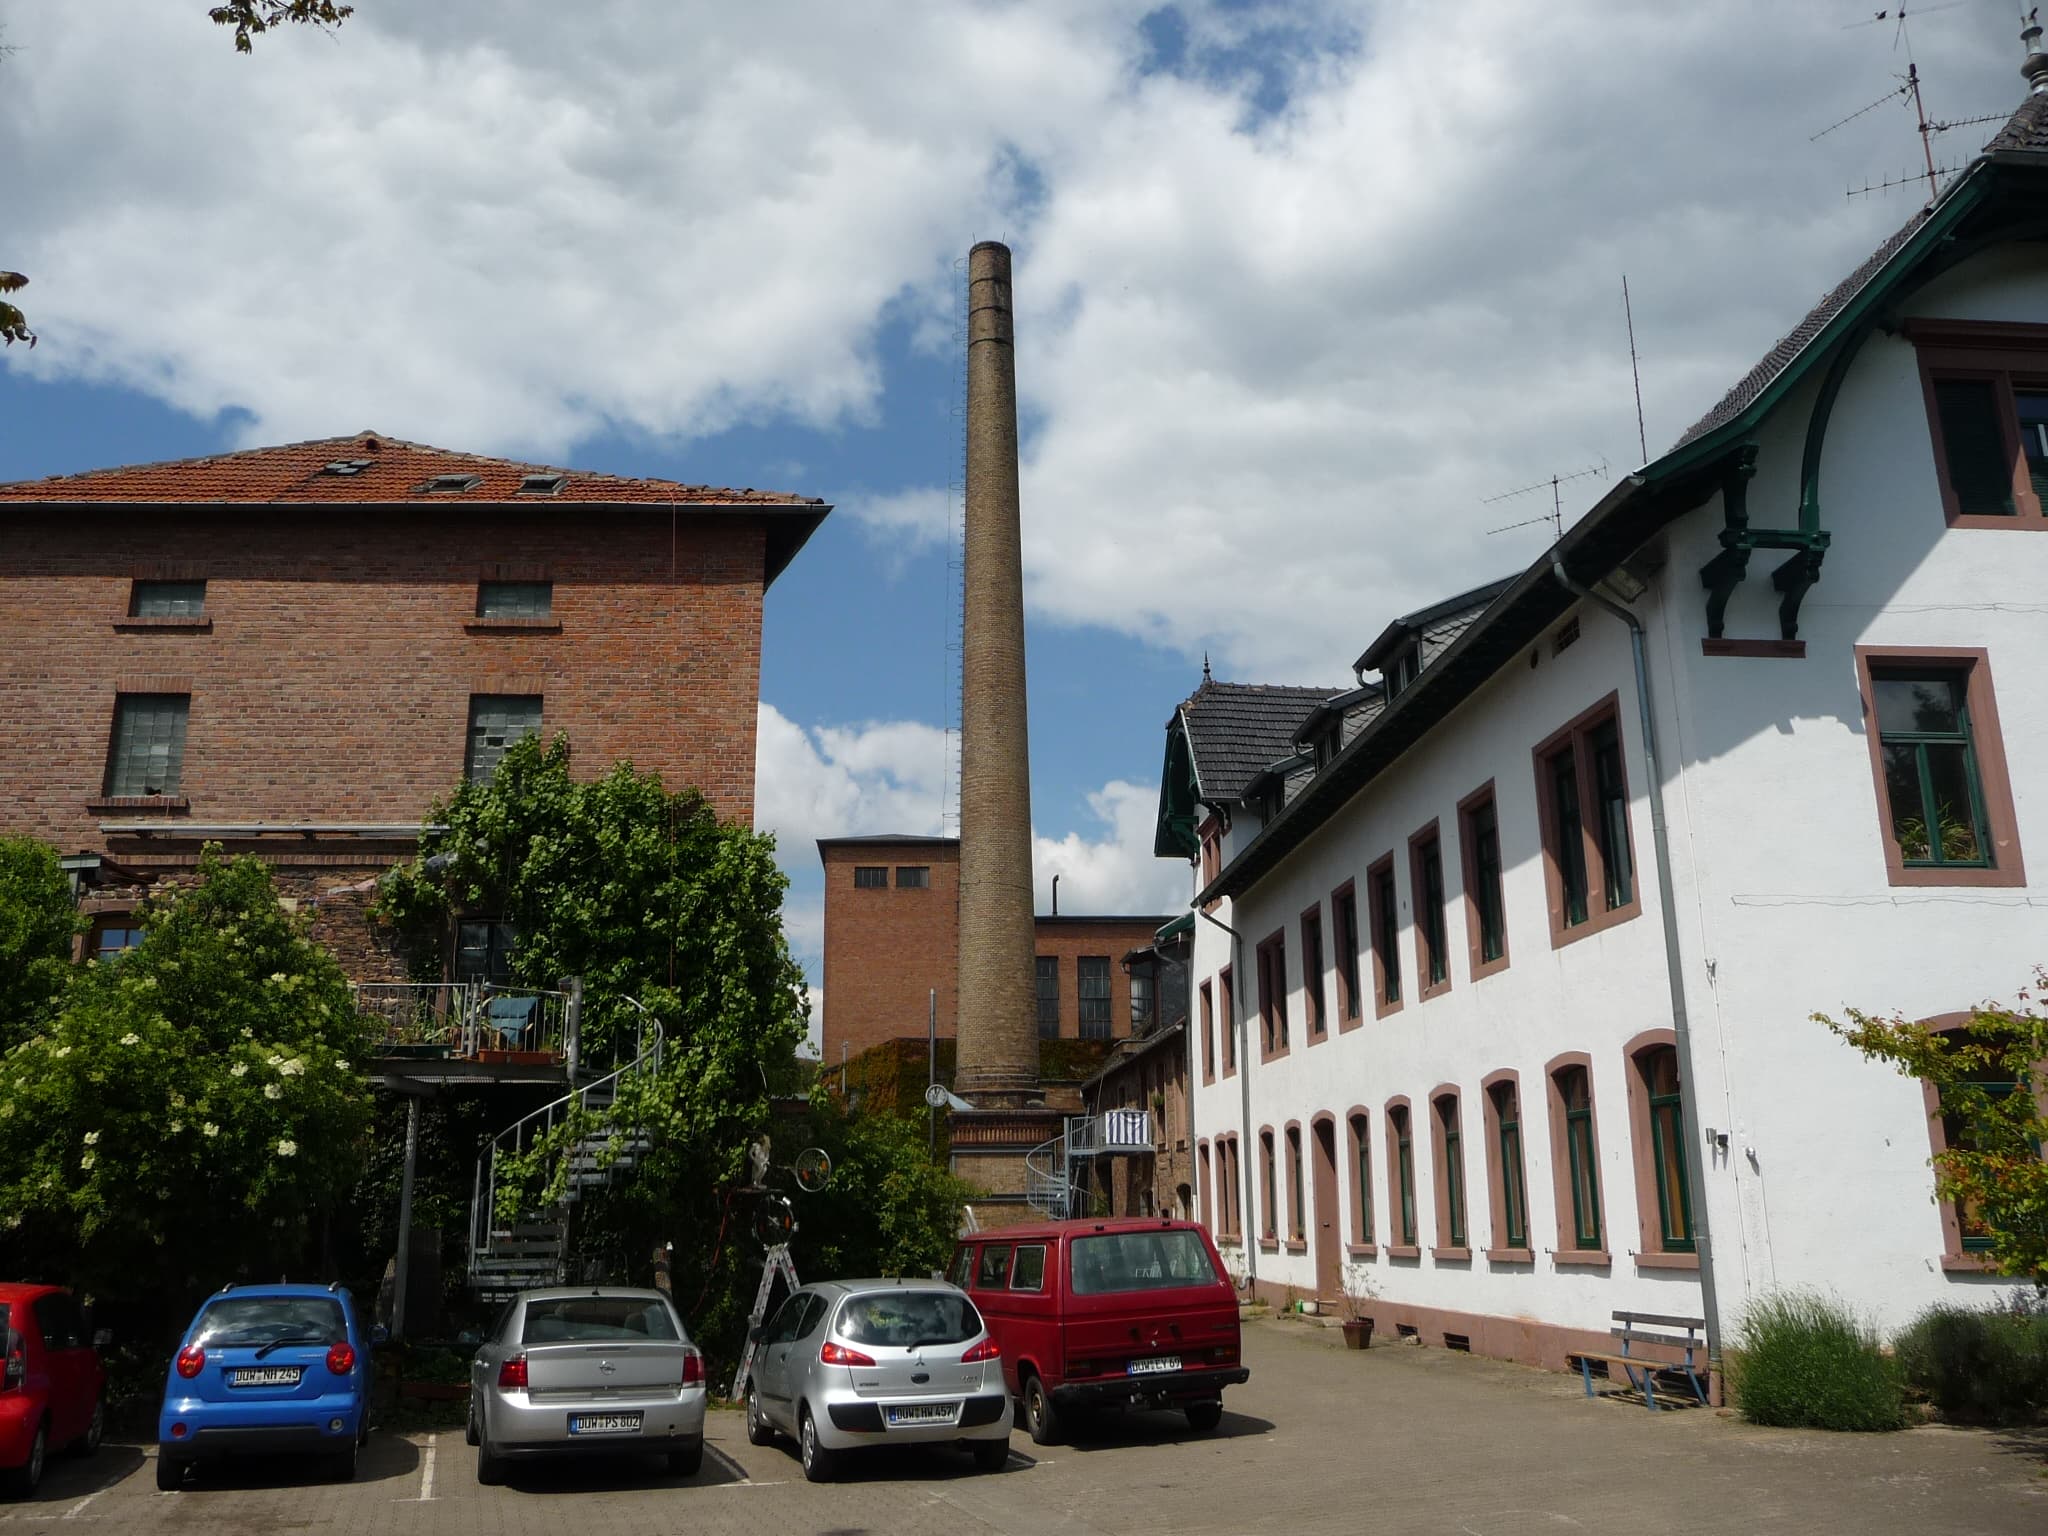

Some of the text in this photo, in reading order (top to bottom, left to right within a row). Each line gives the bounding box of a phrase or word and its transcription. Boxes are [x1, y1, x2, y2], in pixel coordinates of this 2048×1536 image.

[263, 1368, 277, 1380] NH
[935, 1405, 952, 1417] 457
[605, 1415, 618, 1428] PS
[620, 1415, 639, 1427] 802
